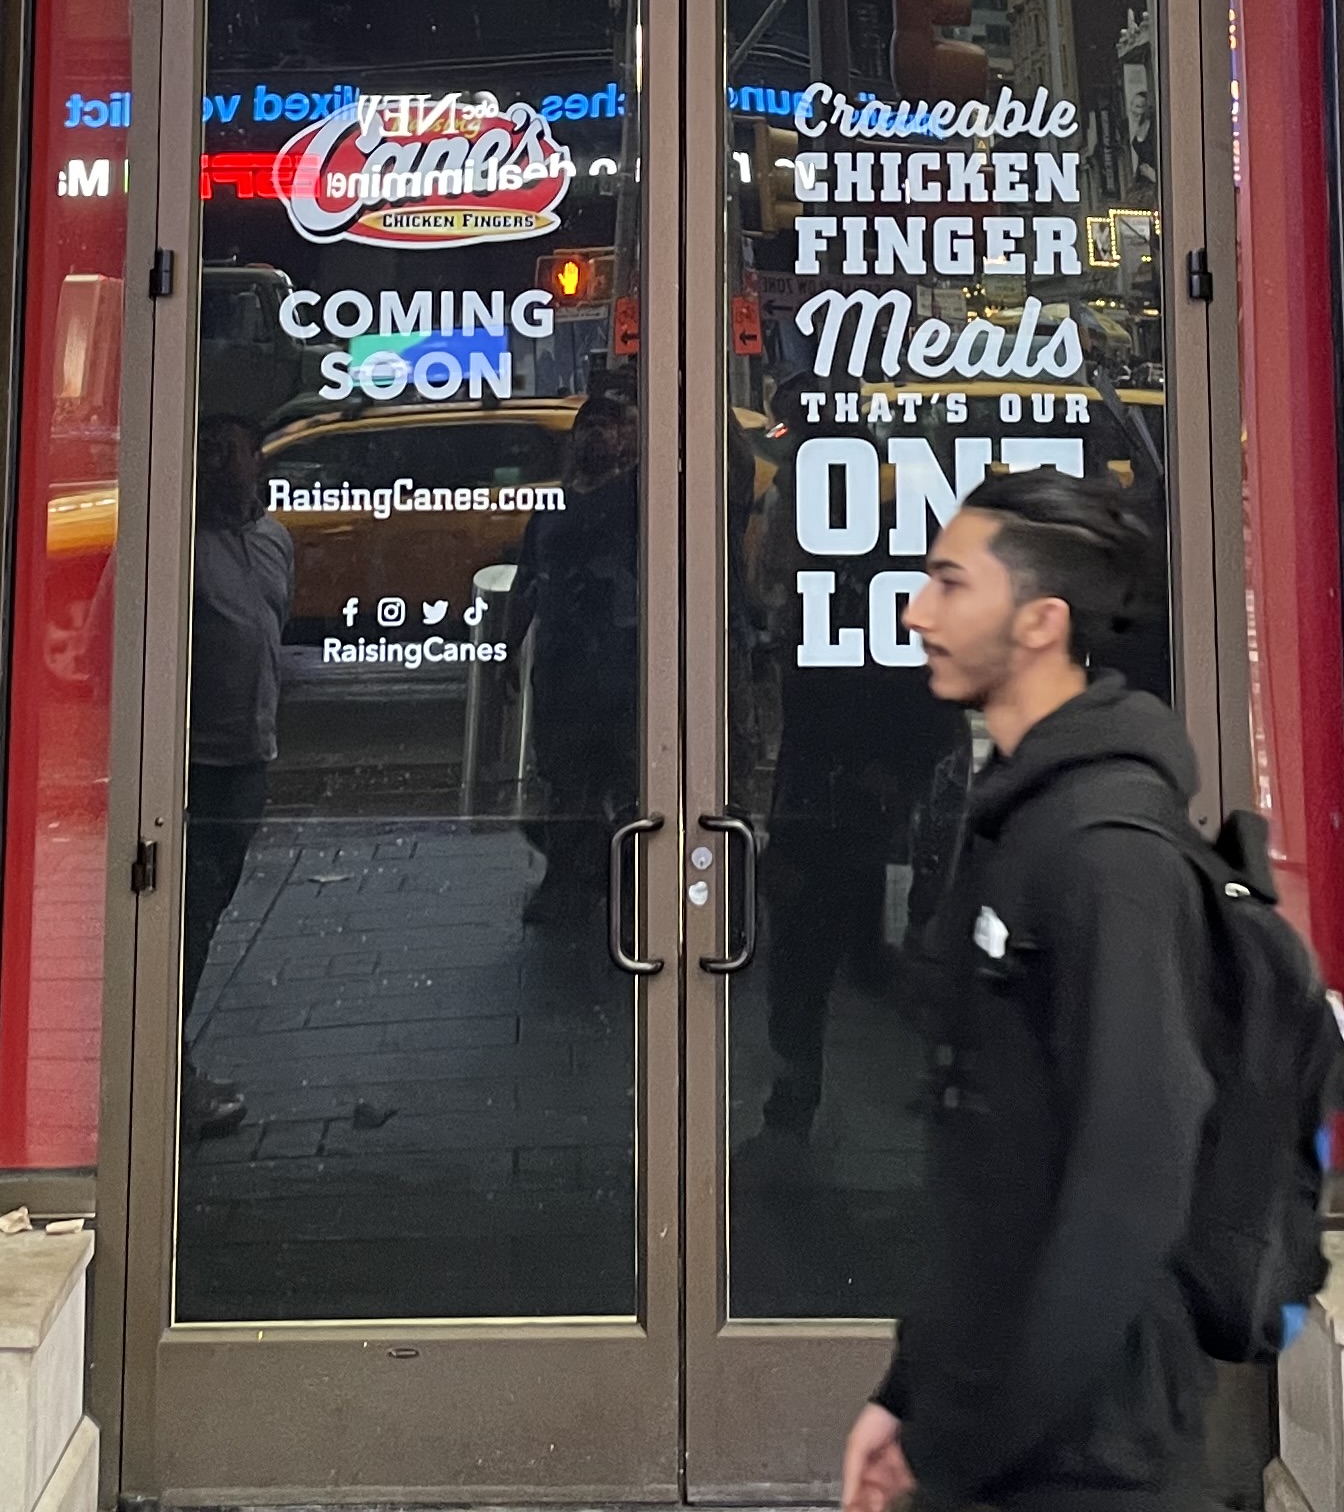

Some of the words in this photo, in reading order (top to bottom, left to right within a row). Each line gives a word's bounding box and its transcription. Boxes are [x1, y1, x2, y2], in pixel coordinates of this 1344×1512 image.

[793, 82, 1079, 139] Craveable
[794, 151, 1080, 204] CHICKEN
[382, 211, 454, 230] CHICKEN
[462, 211, 536, 230] FINGERS
[794, 216, 1082, 276] FINGER
[278, 289, 555, 339] COMING
[793, 287, 1085, 378] Meals
[318, 350, 513, 401] SOON
[800, 391, 968, 424] THAT'S
[999, 393, 1091, 424] OUR
[267, 478, 567, 519] RaisingCanes.com
[323, 636, 508, 669] RaisingCanes
